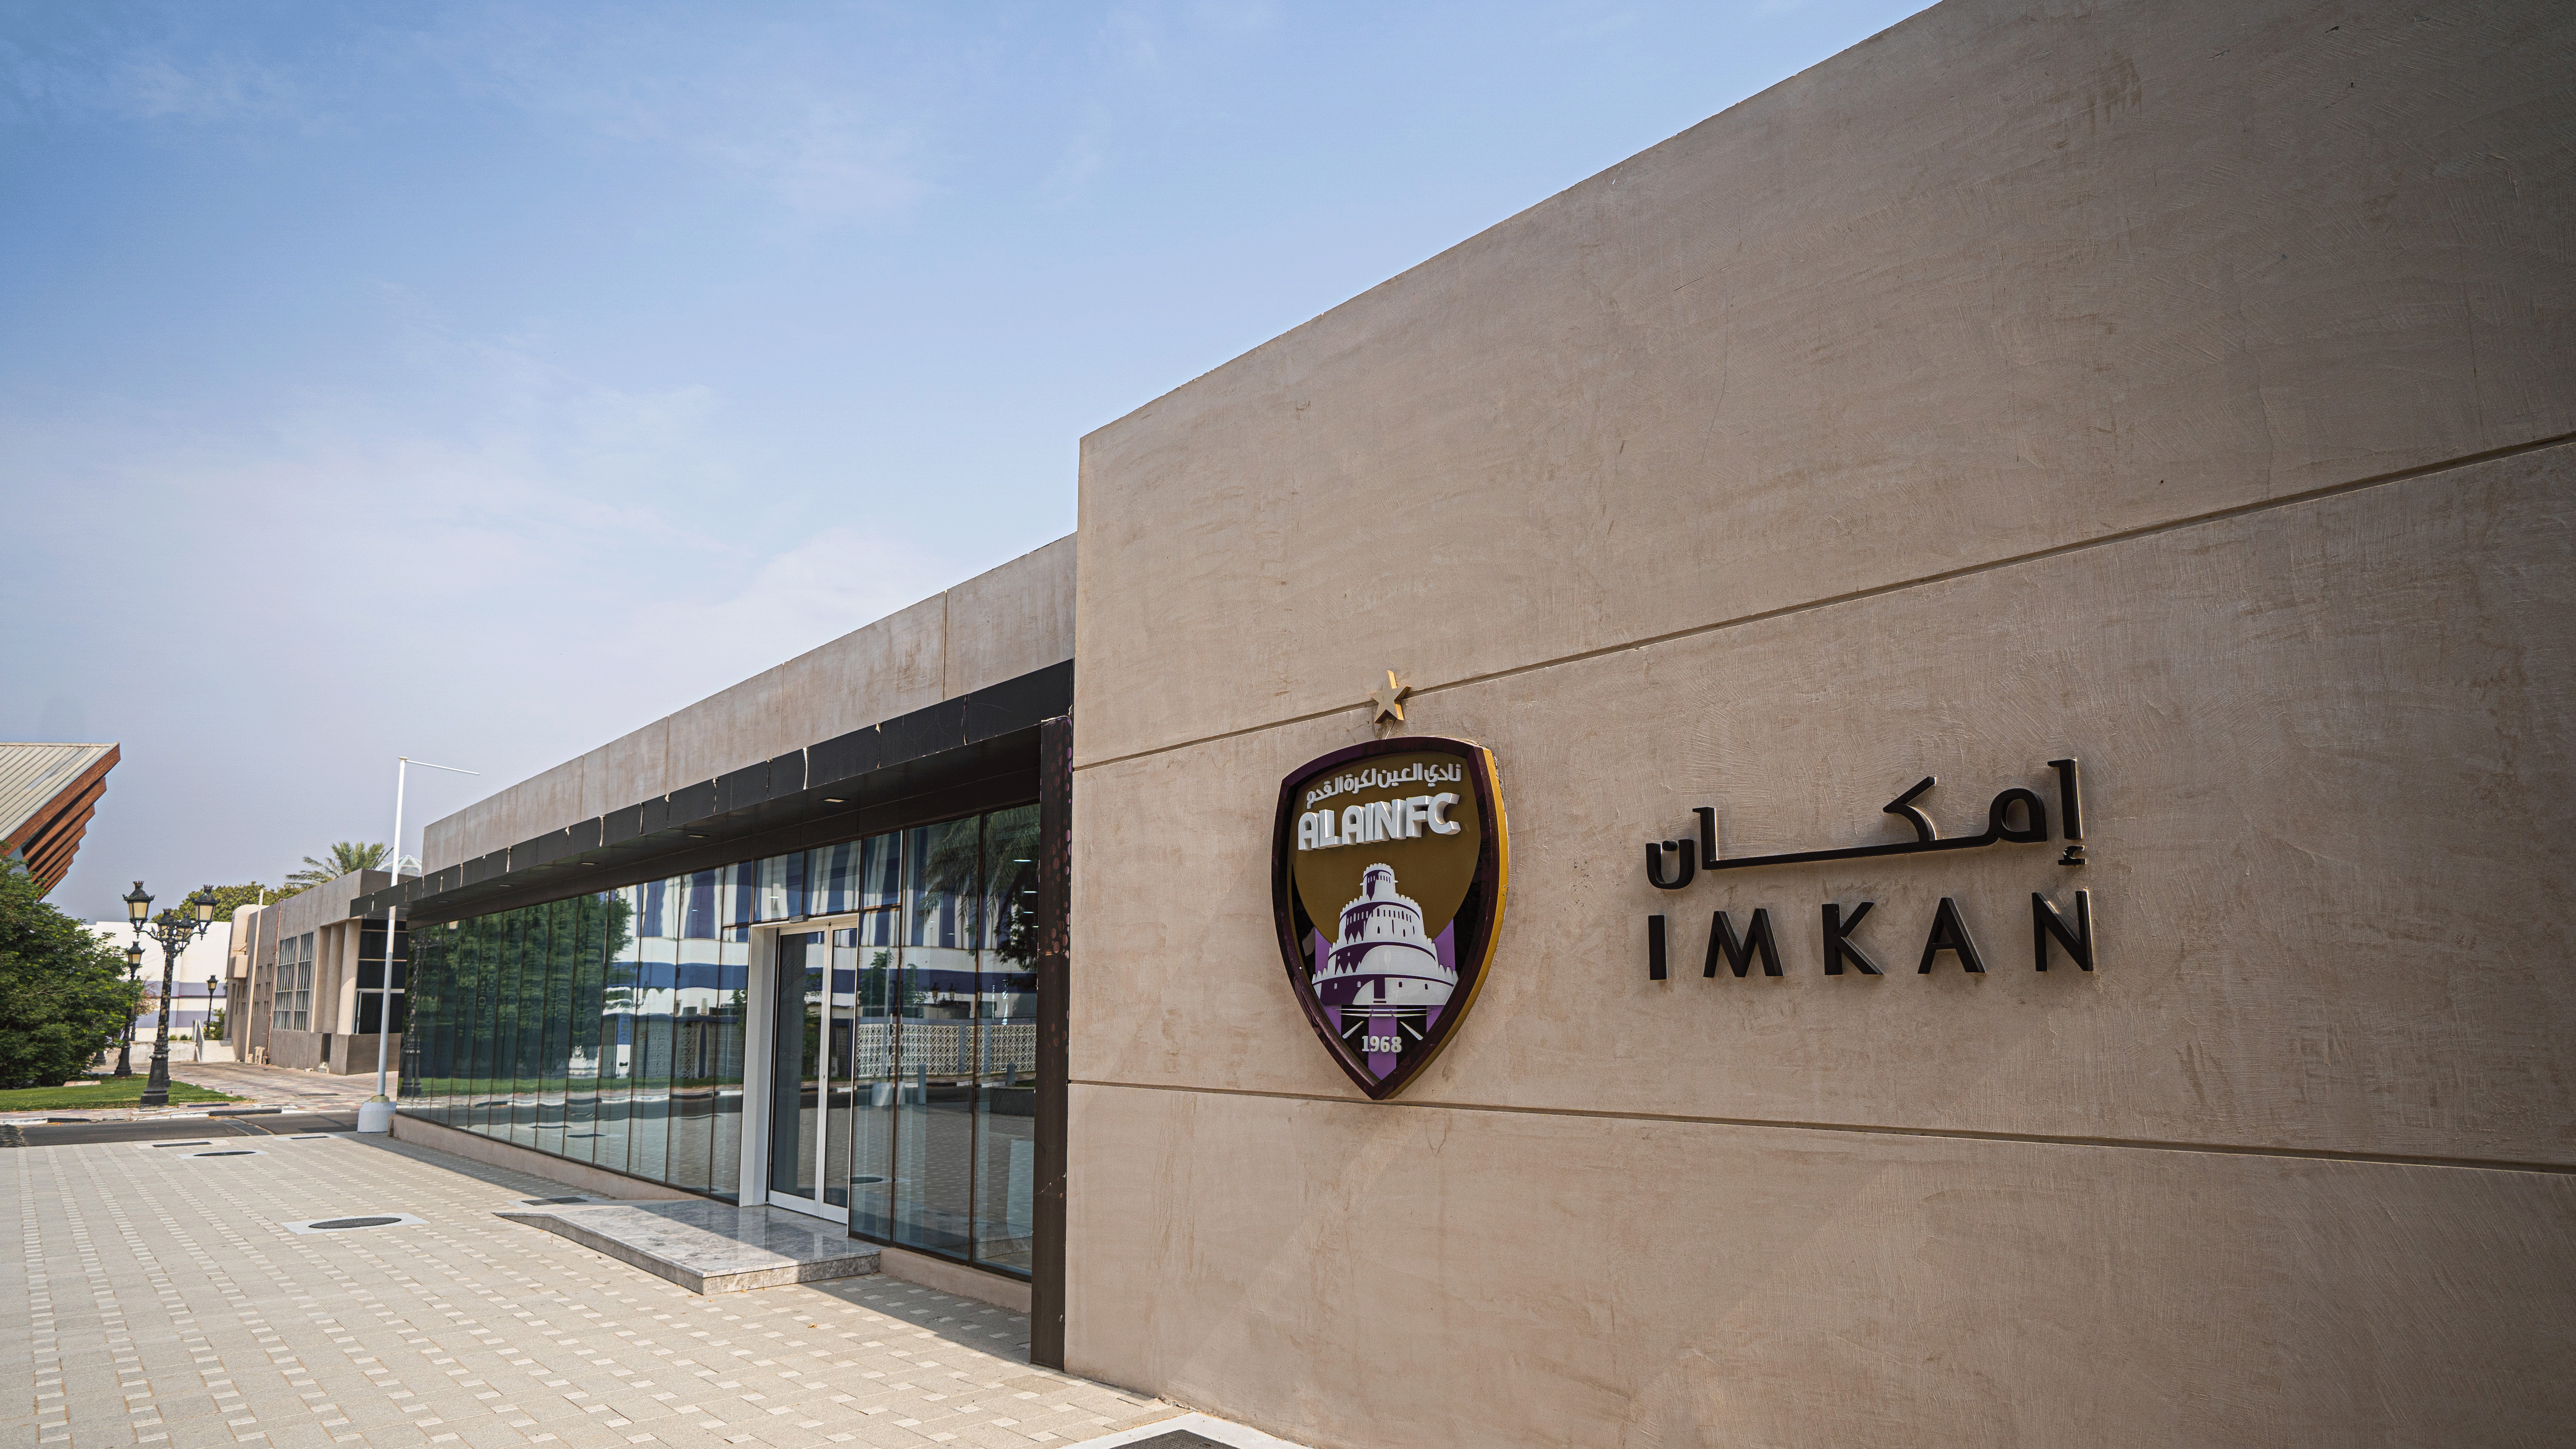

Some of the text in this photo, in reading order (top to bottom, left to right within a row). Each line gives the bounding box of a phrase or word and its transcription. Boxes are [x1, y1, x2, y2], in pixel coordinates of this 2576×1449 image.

[1306, 763, 1461, 809] نادي العين لكرة القدم
[1646, 757, 2087, 890] إمكان
[1647, 890, 2094, 981] IMKAN
[1362, 1036, 1402, 1053] 1968
